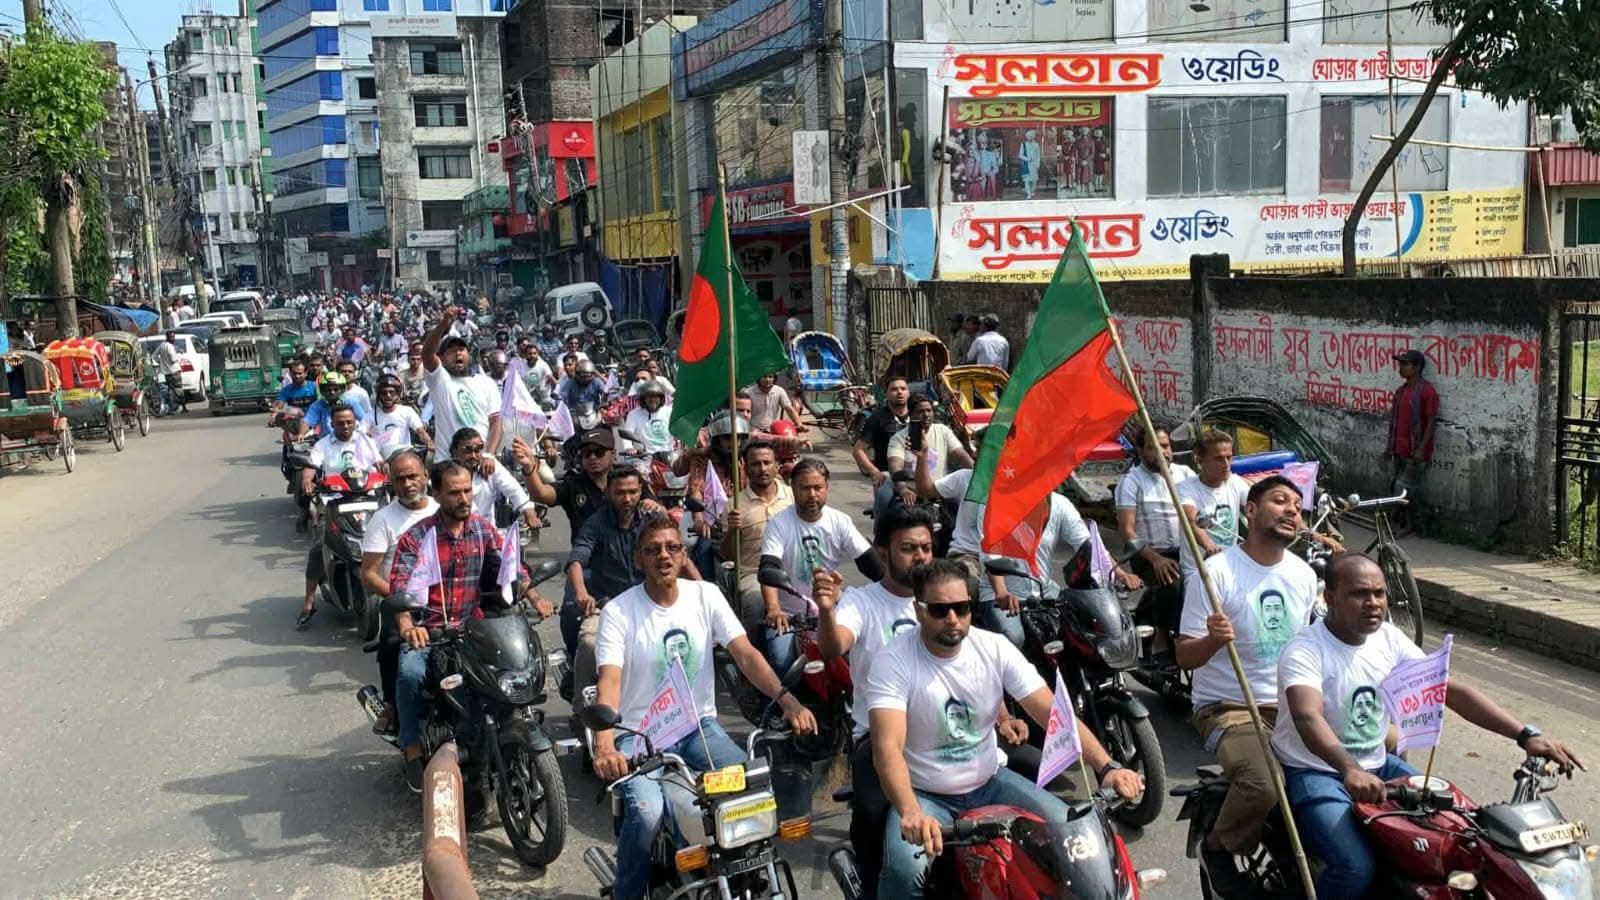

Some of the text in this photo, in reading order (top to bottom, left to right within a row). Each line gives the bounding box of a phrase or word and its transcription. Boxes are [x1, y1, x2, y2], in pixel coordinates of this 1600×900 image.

[1075, 7, 1096, 17] Series
[955, 52, 1165, 96] সুলতান
[1181, 48, 1285, 83] ওয়েডিং
[1312, 58, 1356, 81] ঘোড়ার
[957, 98, 1102, 127] সুলতান
[1260, 205, 1299, 221] ঘোড়ার
[1302, 199, 1328, 220] গাড়ী
[967, 210, 1235, 270] সুলতান ওয়েডিং
[1135, 319, 1184, 360] গড়তে
[1214, 314, 1273, 368] ইসলামী
[1280, 327, 1311, 376] যুব
[1422, 333, 1541, 385] বাংলাদেশ
[1152, 360, 1184, 407] দিন
[650, 687, 677, 718] দফা
